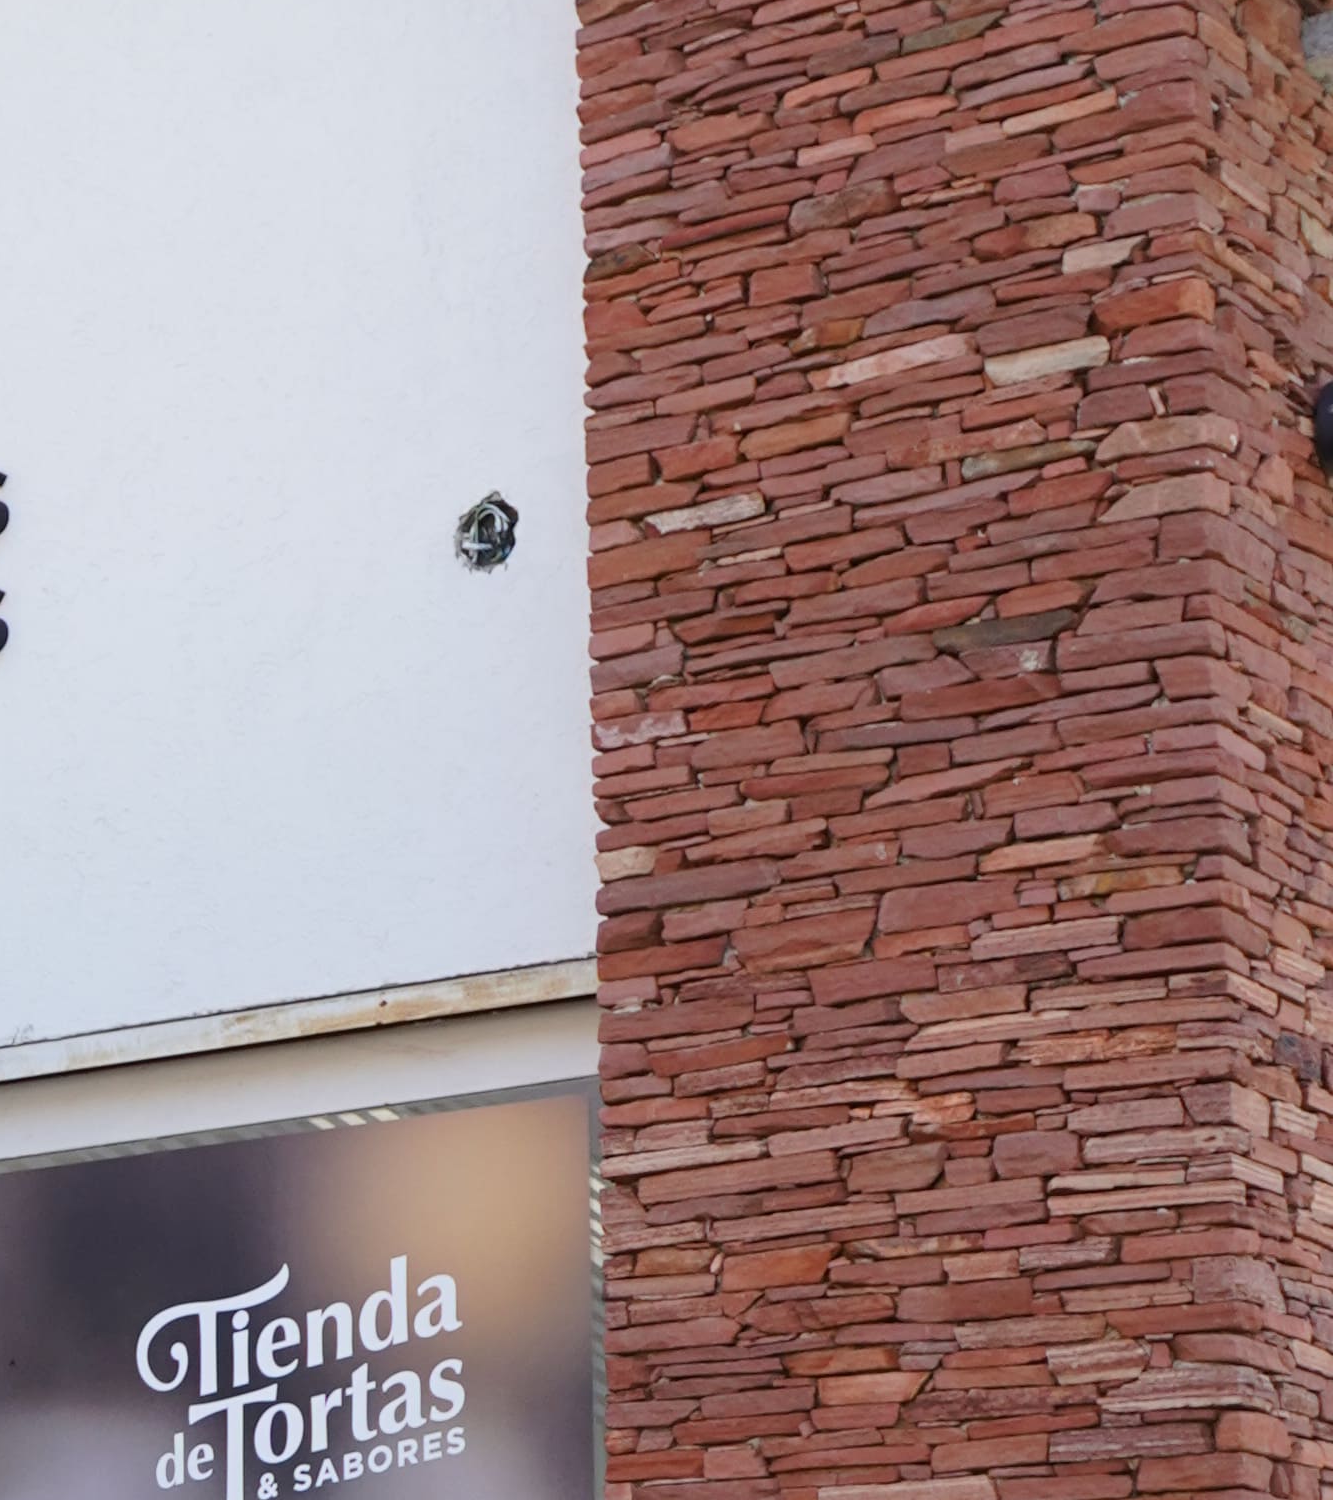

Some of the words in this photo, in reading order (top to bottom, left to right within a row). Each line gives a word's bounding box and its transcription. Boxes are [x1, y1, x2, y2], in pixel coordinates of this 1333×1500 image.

[136, 1255, 463, 1396] Tienda
[156, 1433, 214, 1489] de
[257, 1472, 279, 1500] &
[293, 1427, 466, 1491] SABORES
